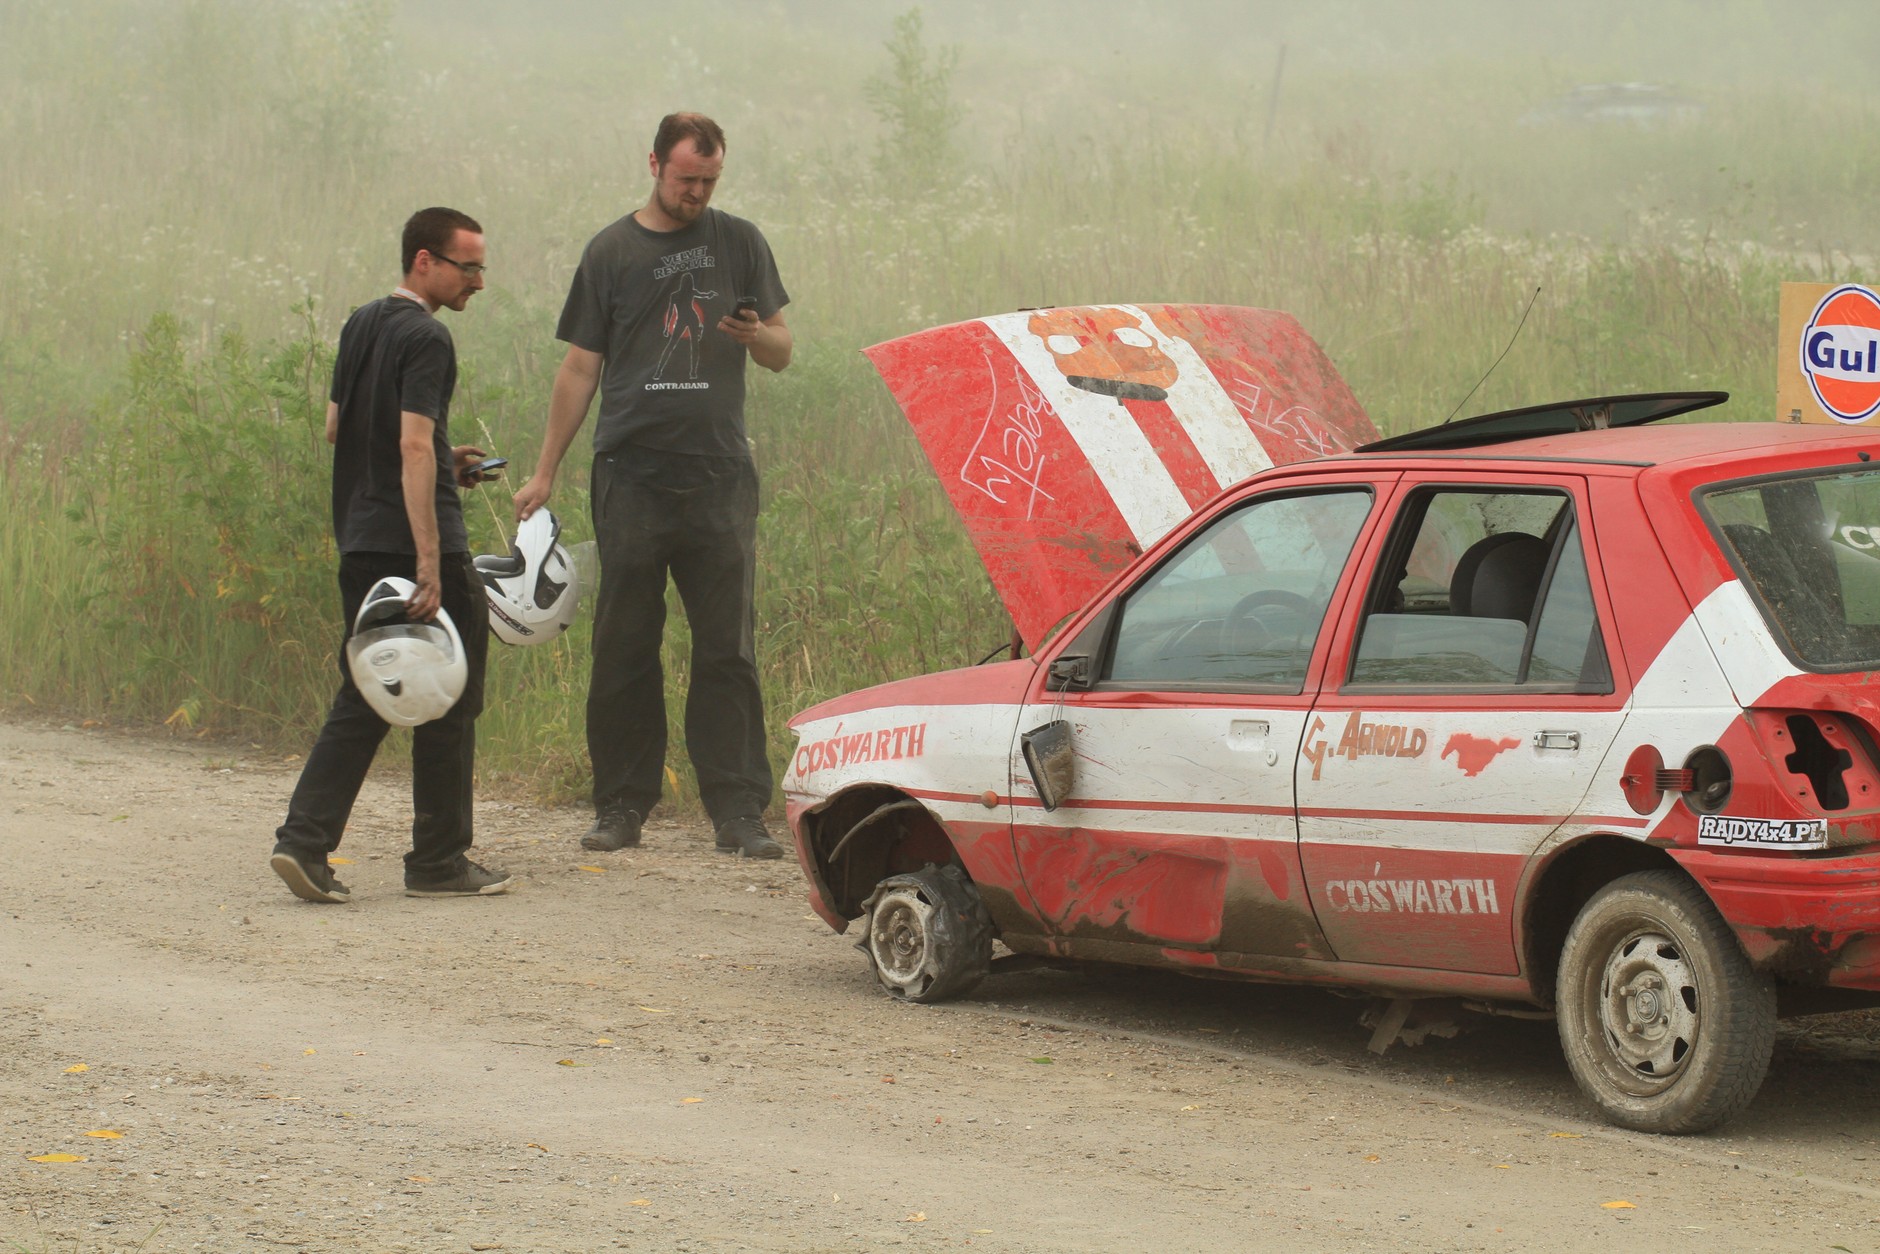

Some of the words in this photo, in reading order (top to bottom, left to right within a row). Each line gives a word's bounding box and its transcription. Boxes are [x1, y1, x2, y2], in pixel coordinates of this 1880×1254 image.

[653, 255, 715, 280] REVOLVER
[660, 245, 708, 267] VELVET
[1807, 330, 1878, 374] Gul
[644, 382, 710, 391] CONTRABAND
